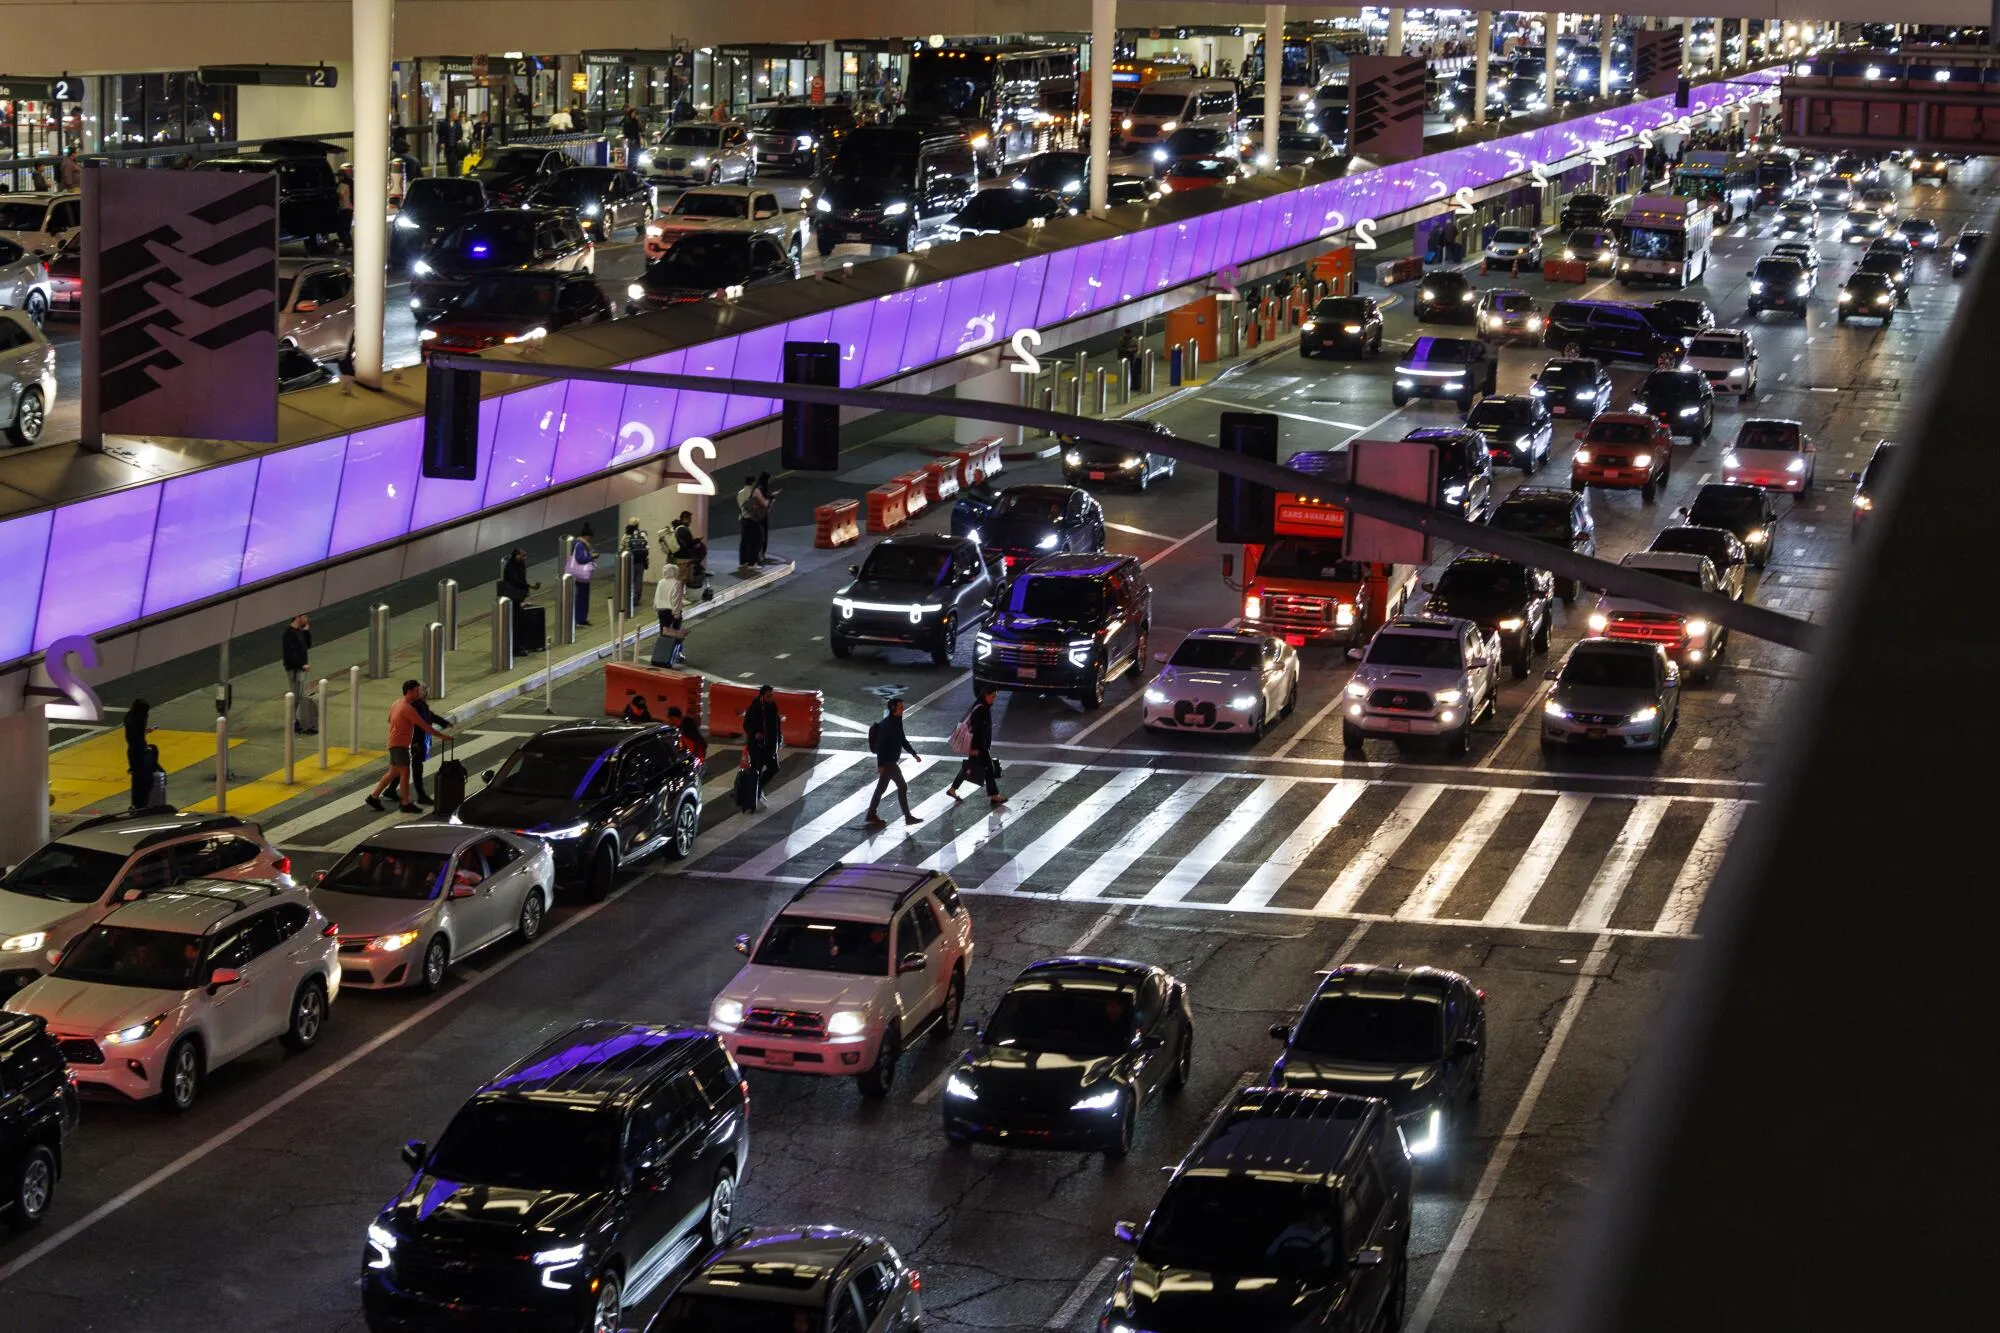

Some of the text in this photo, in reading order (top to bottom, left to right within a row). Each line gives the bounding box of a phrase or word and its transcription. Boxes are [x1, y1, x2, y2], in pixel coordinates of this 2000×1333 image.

[1179, 29, 1186, 39] 2
[803, 46, 813, 59] 2
[675, 53, 684, 66] 2
[517, 61, 527, 75] 2
[314, 70, 326, 86] 2
[56, 80, 69, 99] 2
[1282, 509, 1303, 519] CARS
